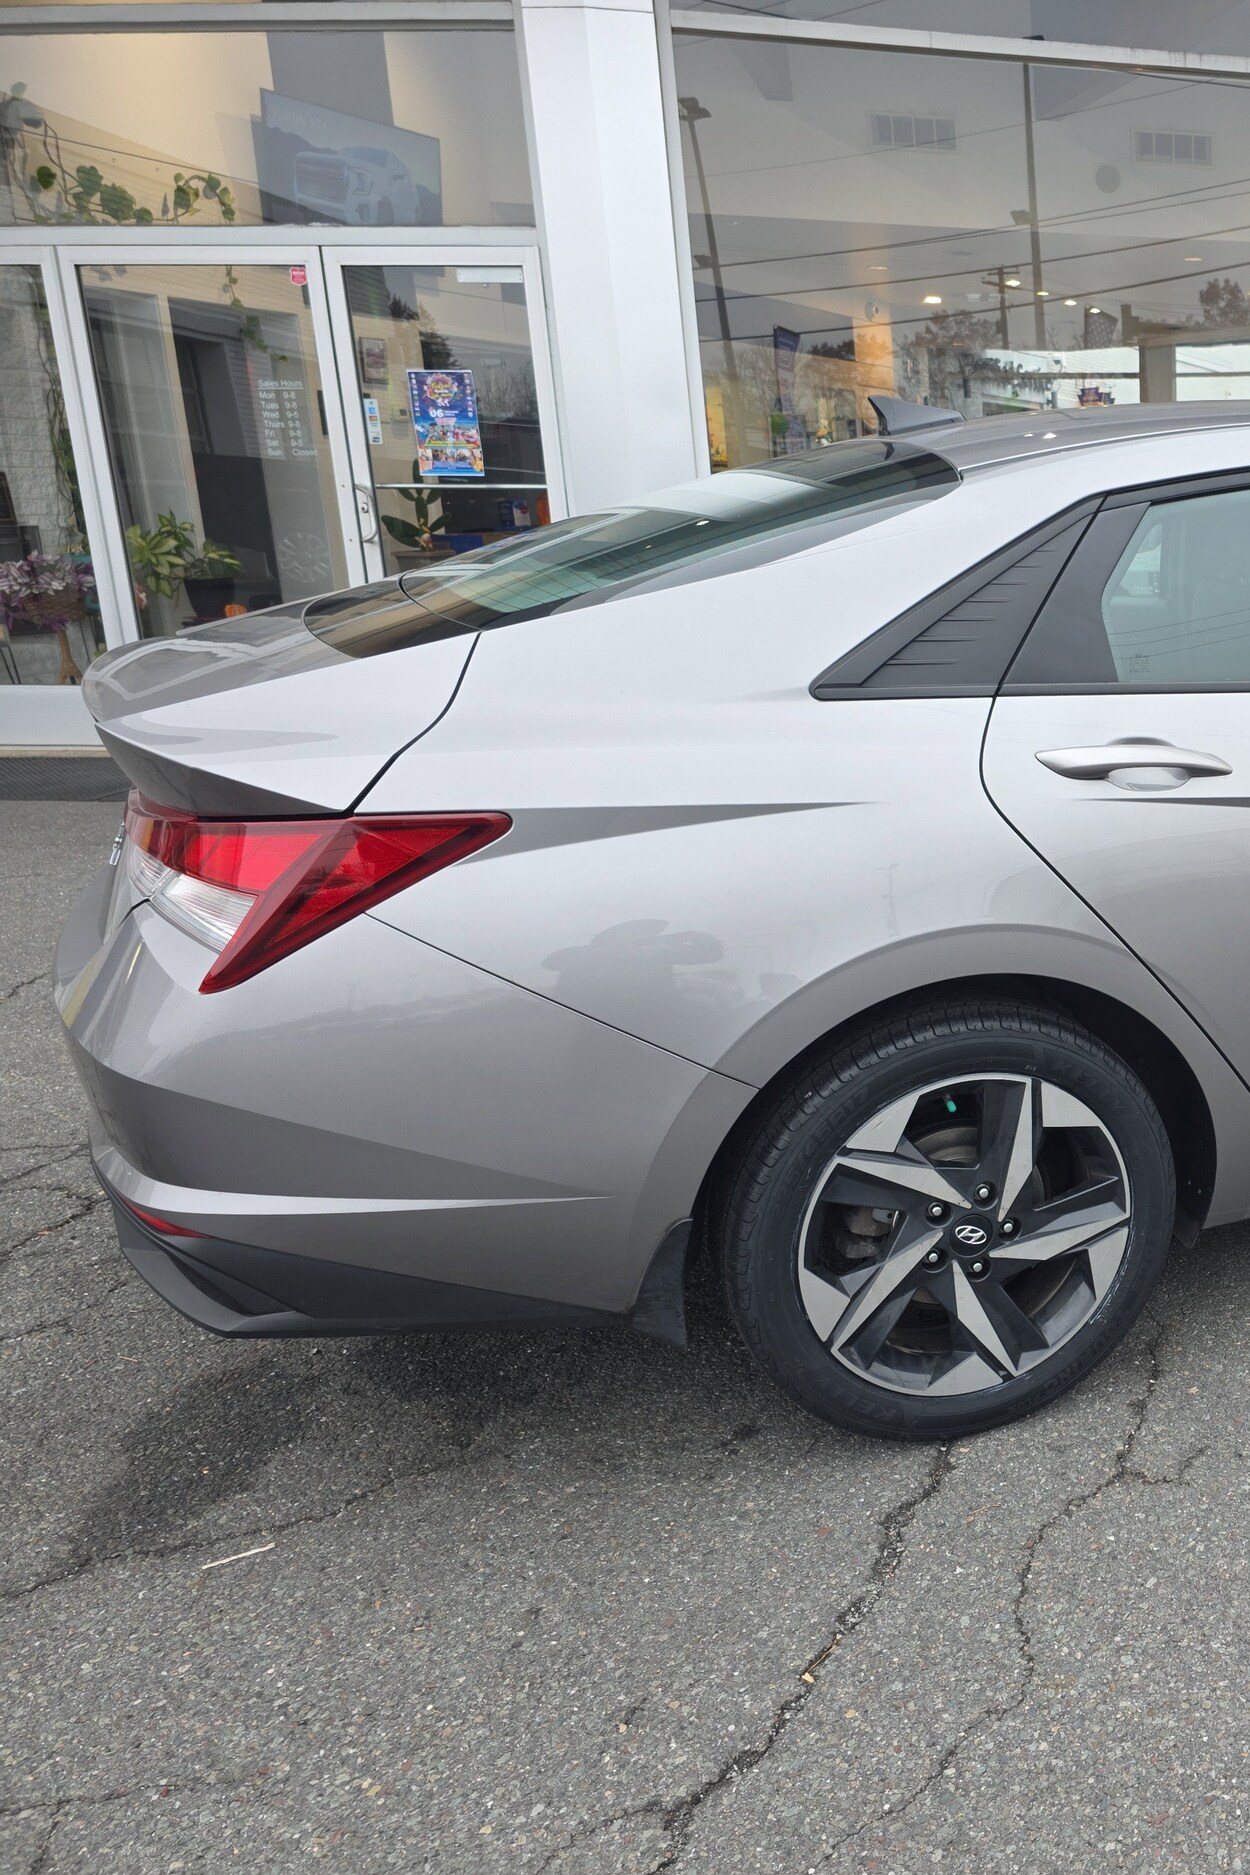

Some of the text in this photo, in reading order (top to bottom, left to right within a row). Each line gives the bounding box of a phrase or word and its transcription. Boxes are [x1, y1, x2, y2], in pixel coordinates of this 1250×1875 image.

[258, 379, 303, 387] Sales Hours
[259, 391, 276, 399] Mon
[261, 401, 280, 410] Tues
[262, 411, 280, 419] Wed
[264, 420, 285, 428] Thurs
[265, 429, 275, 437] Fri
[266, 439, 279, 447] Sat
[268, 448, 317, 456] Sun Closed
[810, 1374, 900, 1424] KELLY
